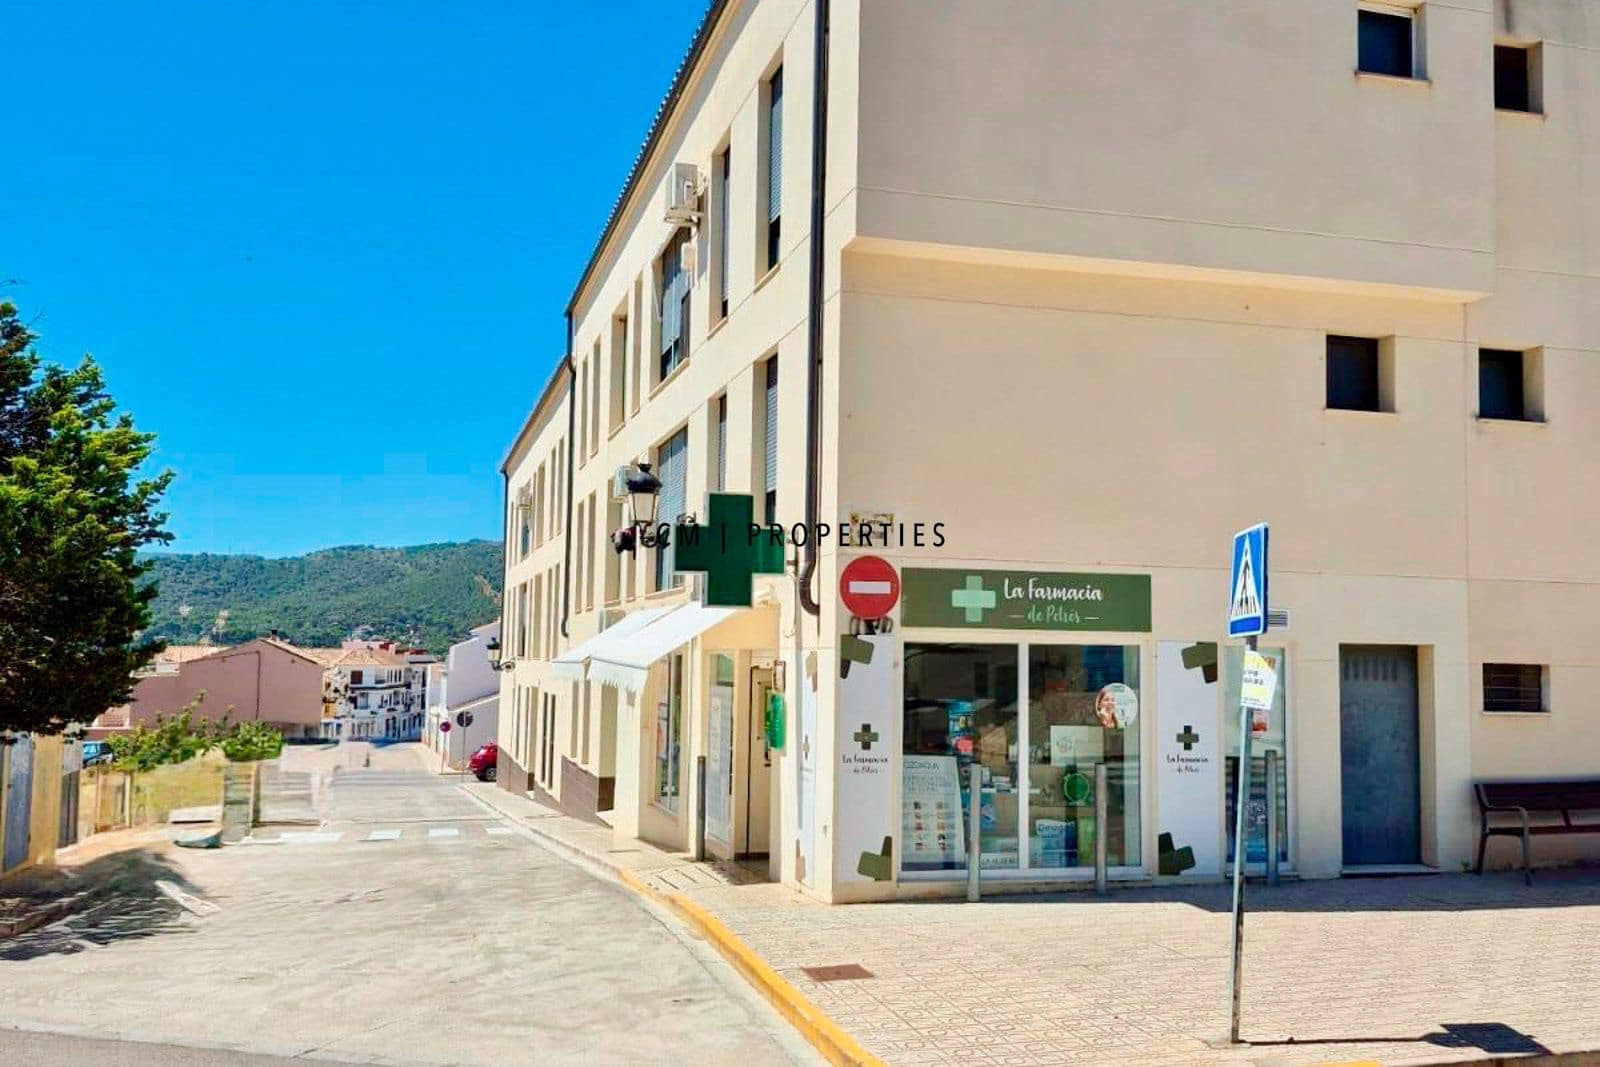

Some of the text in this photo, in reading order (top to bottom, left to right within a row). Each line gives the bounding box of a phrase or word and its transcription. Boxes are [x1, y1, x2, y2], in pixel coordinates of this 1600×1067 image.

[1004, 577, 1103, 601] La Farmacia
[1027, 604, 1042, 623] de
